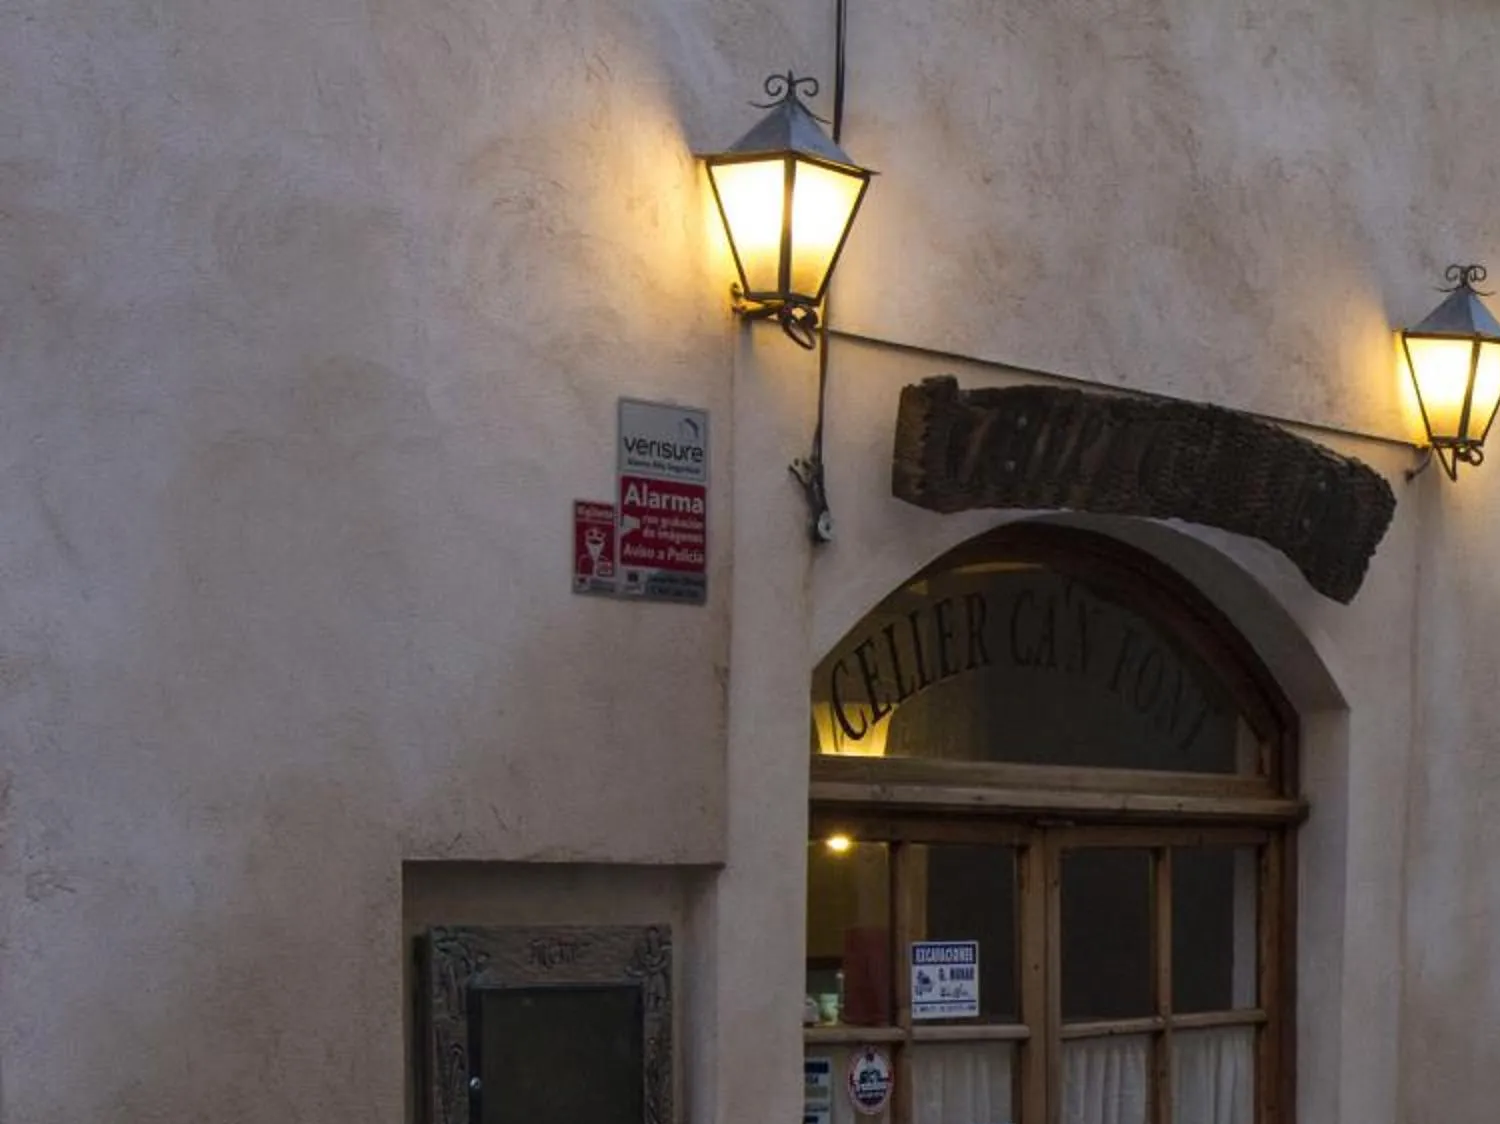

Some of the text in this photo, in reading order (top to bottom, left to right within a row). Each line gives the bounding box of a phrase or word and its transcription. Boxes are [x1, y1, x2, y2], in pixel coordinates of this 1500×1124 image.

[624, 436, 704, 463] verisure
[624, 482, 704, 514] Alarma
[829, 593, 993, 740] CELLER
